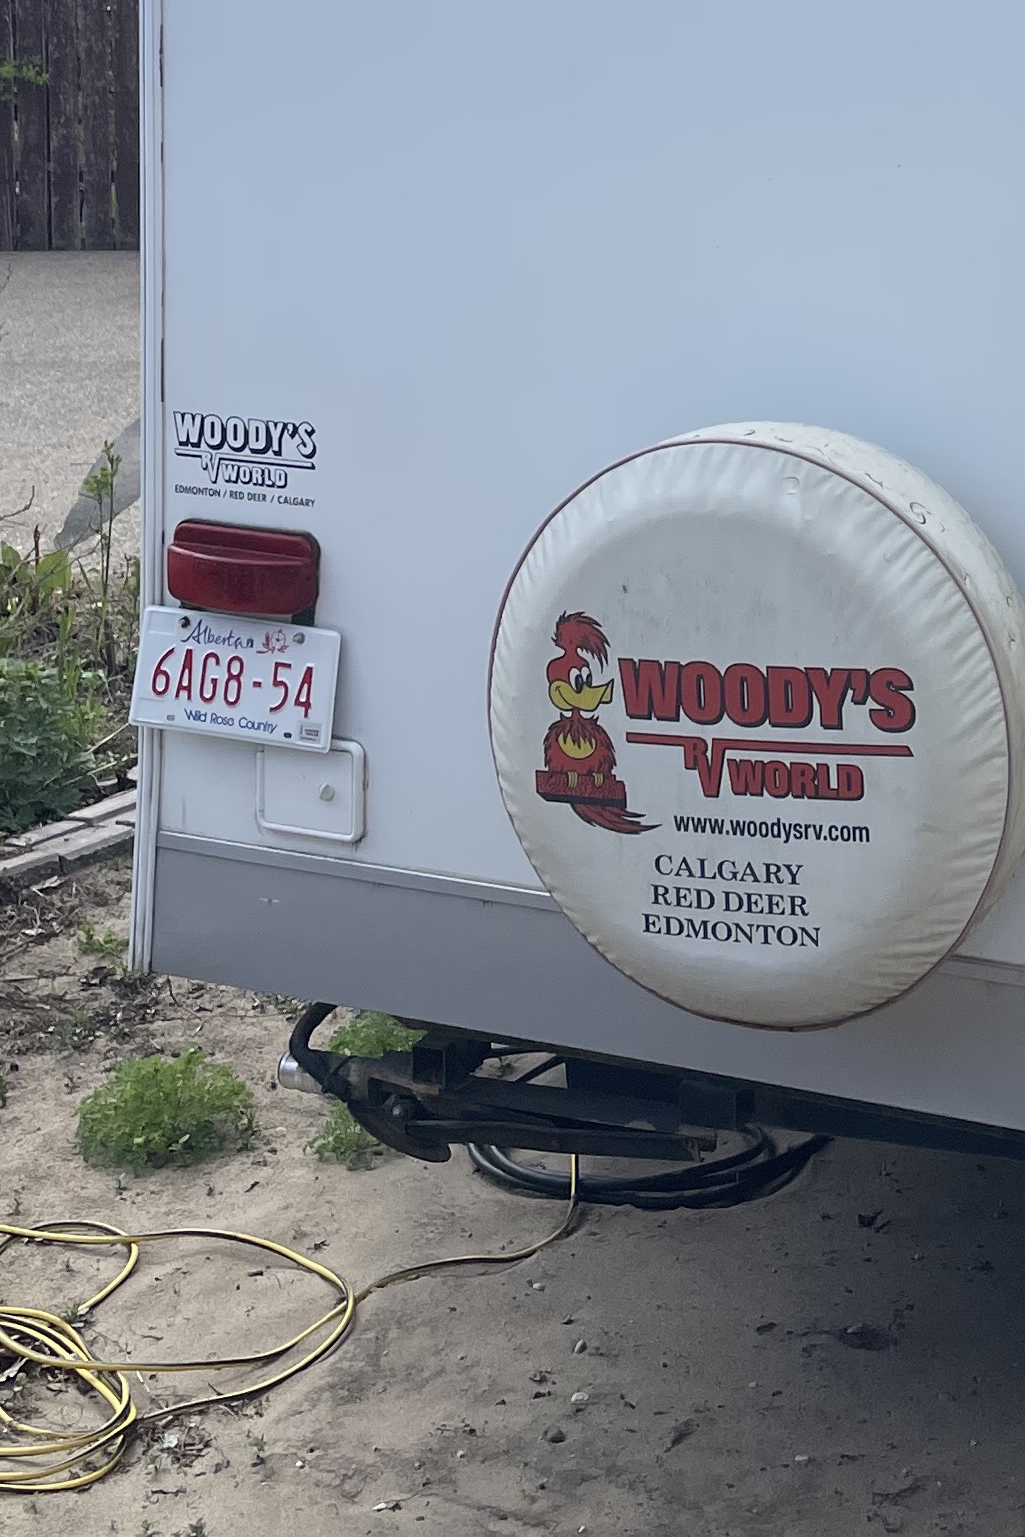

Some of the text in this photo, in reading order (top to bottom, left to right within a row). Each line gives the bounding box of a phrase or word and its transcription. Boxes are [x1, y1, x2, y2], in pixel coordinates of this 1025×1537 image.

[173, 411, 317, 460] WOODY'S
[221, 463, 288, 489] WORLD
[174, 484, 221, 497] EDMONTON
[229, 490, 245, 500] RED
[246, 492, 267, 502] DEER
[277, 495, 316, 508] CALGARY
[181, 619, 250, 650] Alberta
[151, 645, 315, 718] 6AG8-54
[617, 657, 916, 733] WOODY'S
[184, 708, 278, 734] Wild Rose Country
[683, 737, 865, 801] RV WORLD
[674, 815, 871, 844] www.woodysrv.com
[654, 854, 804, 885] CALGARY
[651, 883, 809, 917] RED DEER
[641, 913, 821, 948] EDMONTON
